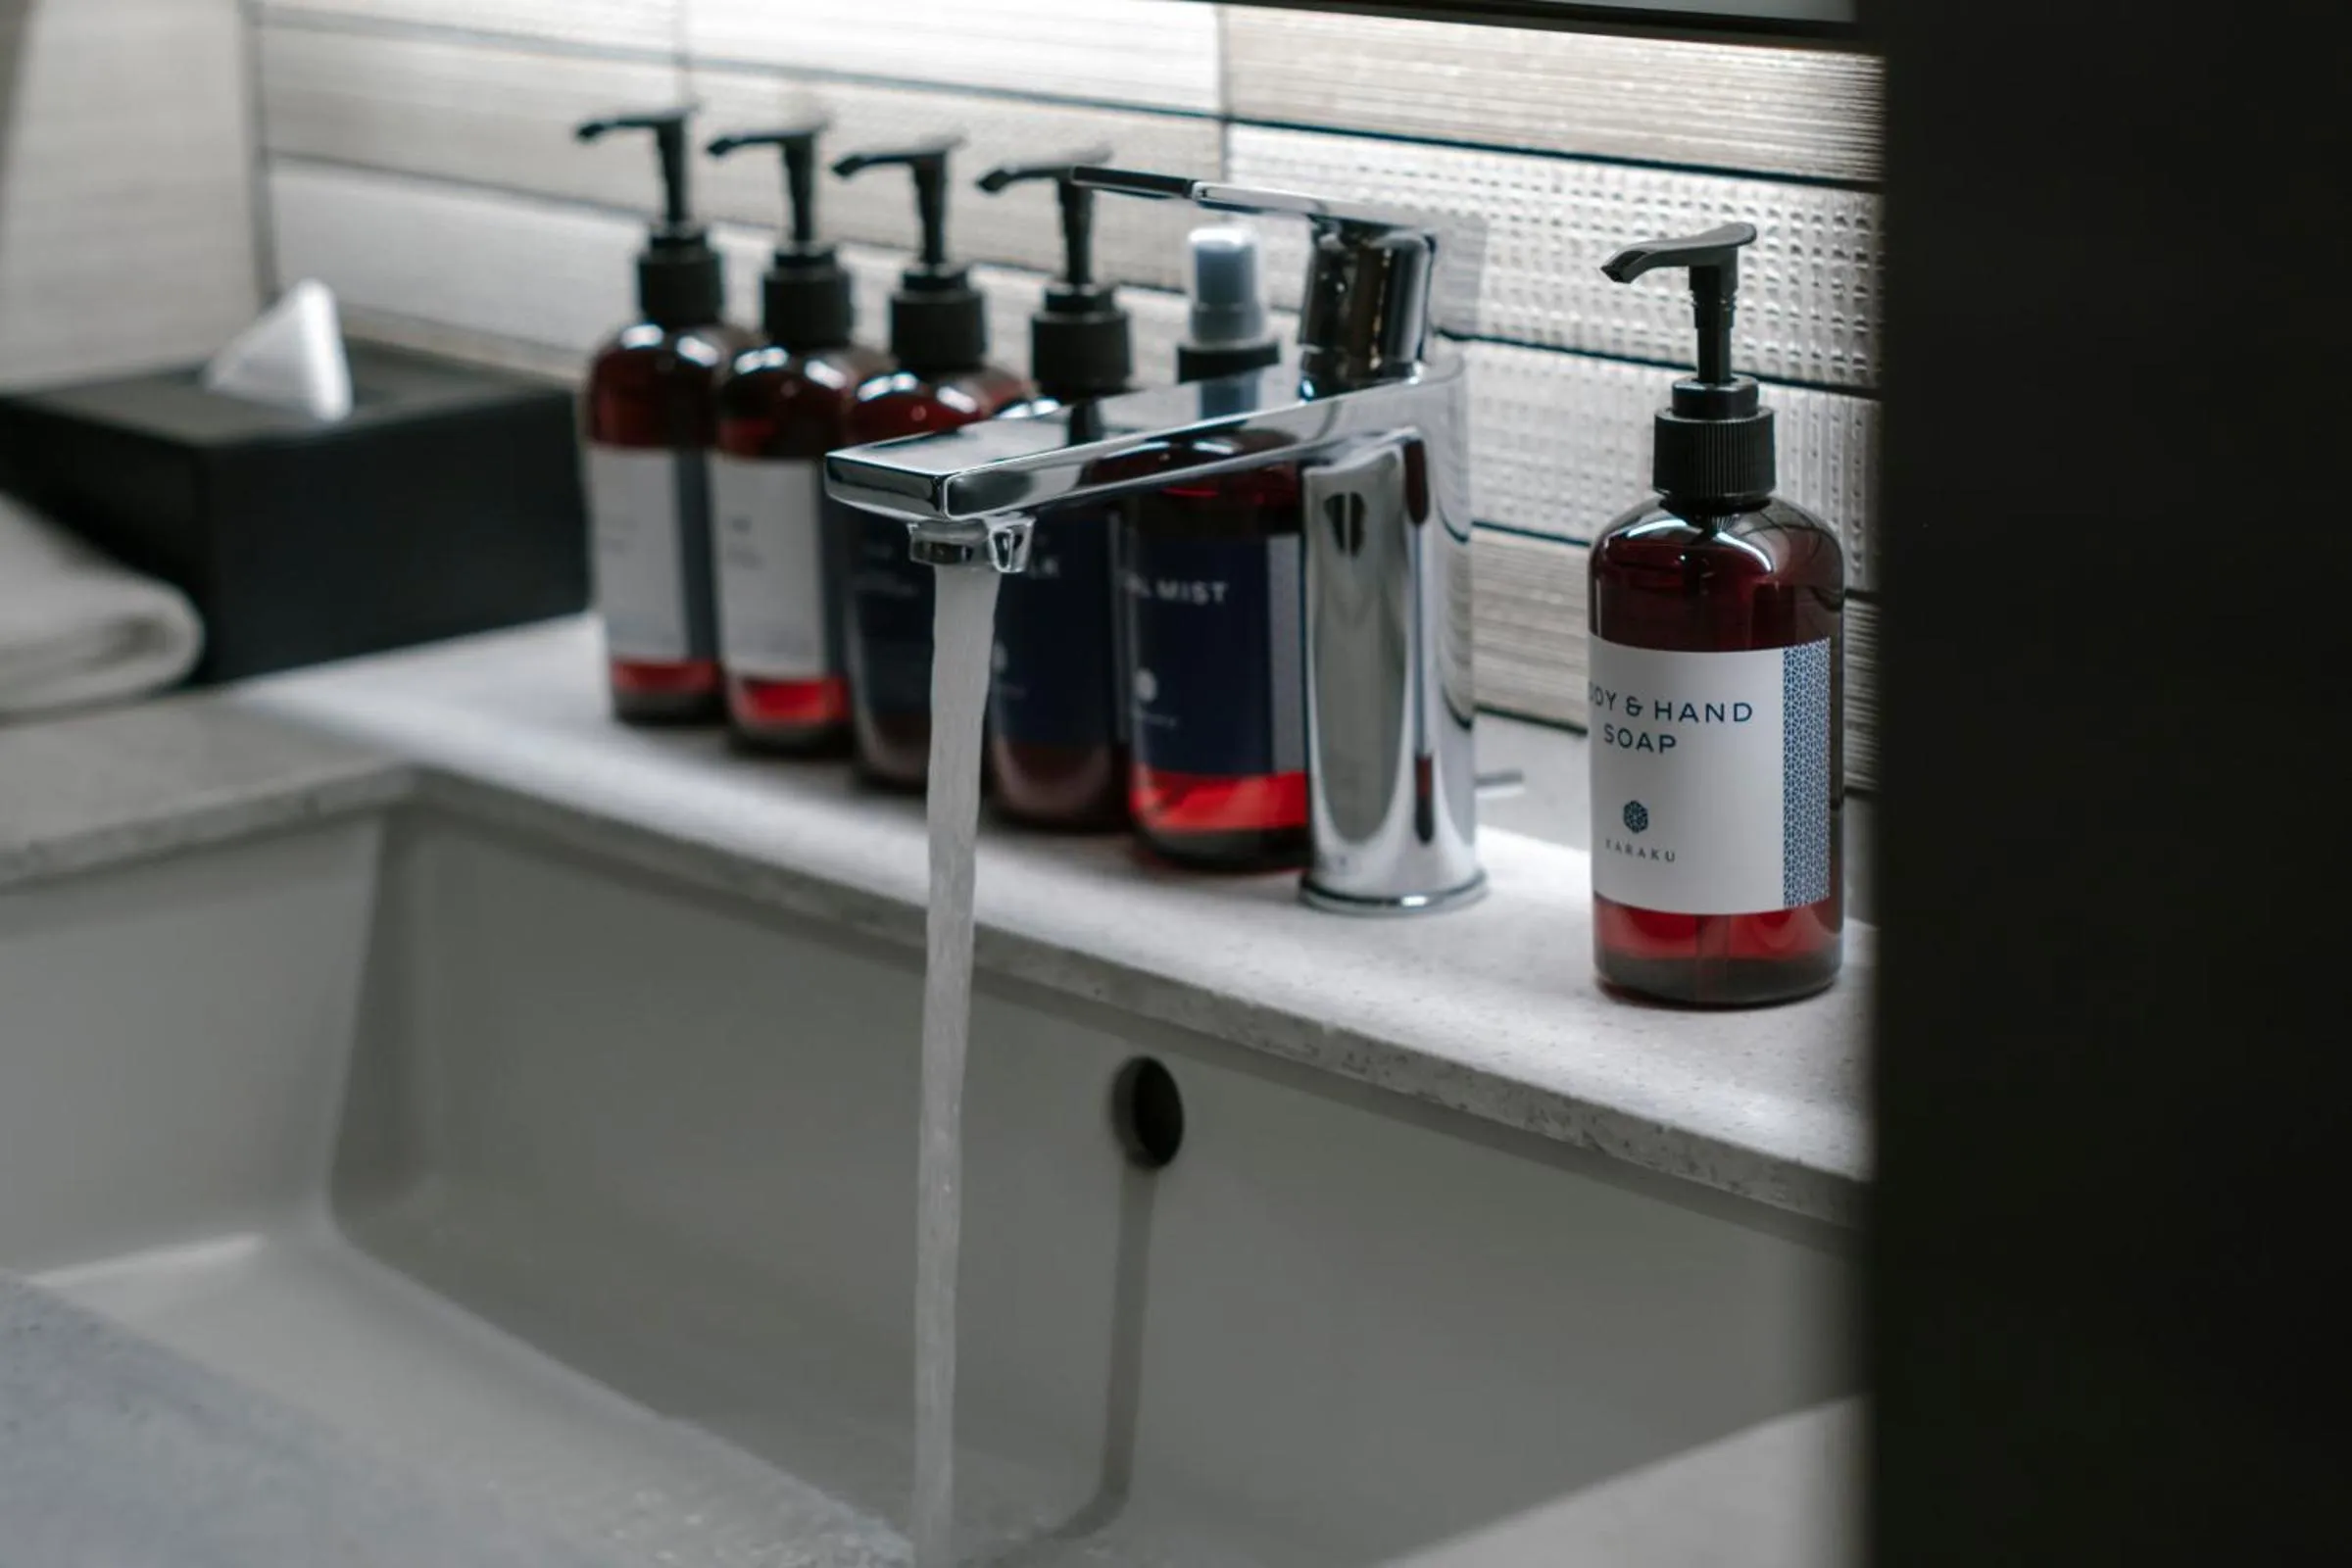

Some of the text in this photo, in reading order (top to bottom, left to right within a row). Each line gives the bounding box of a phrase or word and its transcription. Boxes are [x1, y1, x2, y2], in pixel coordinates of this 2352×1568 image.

[1626, 695, 1643, 717] &
[1654, 699, 1753, 723] HAND
[1603, 723, 1677, 754] SOAP
